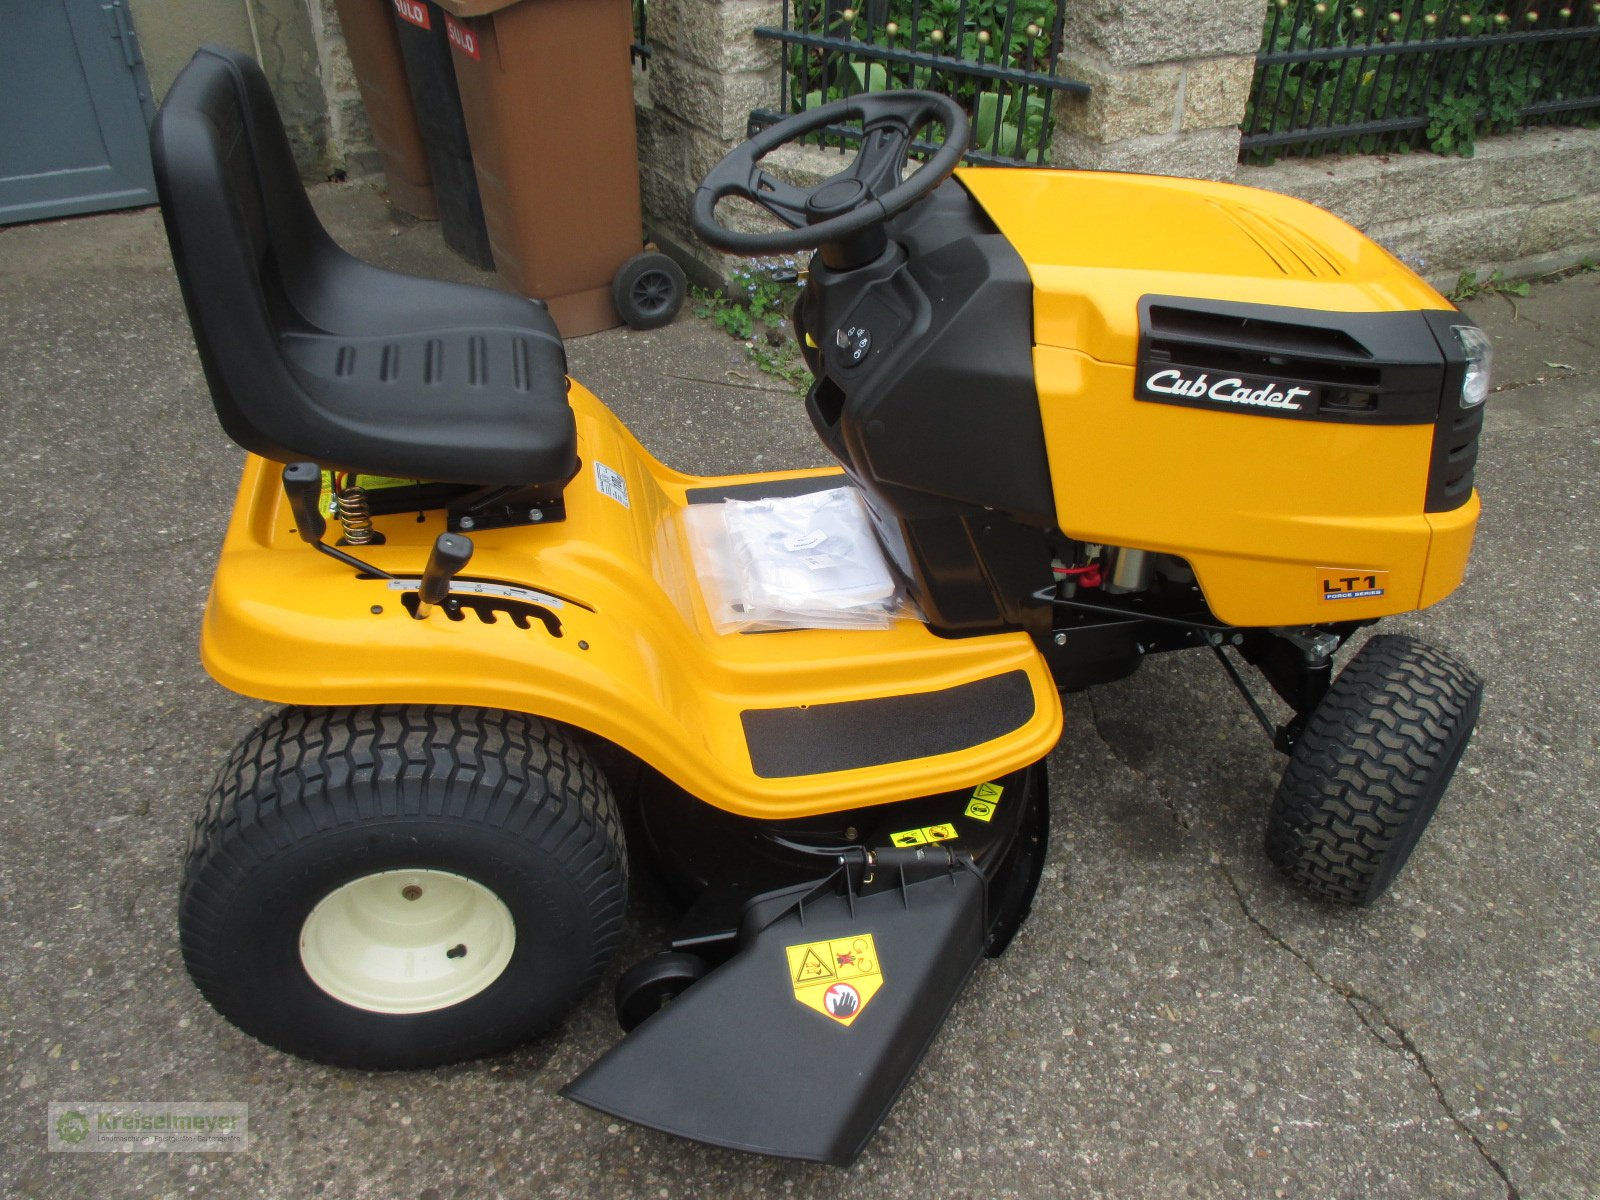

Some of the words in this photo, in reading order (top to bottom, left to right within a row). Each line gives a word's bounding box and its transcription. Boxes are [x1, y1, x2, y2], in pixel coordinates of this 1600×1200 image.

[394, 0, 423, 23] SULO
[448, 22, 474, 53] SULO
[1146, 369, 1207, 397] Cub
[1207, 378, 1312, 410] Cadet
[1324, 576, 1375, 592] LT1
